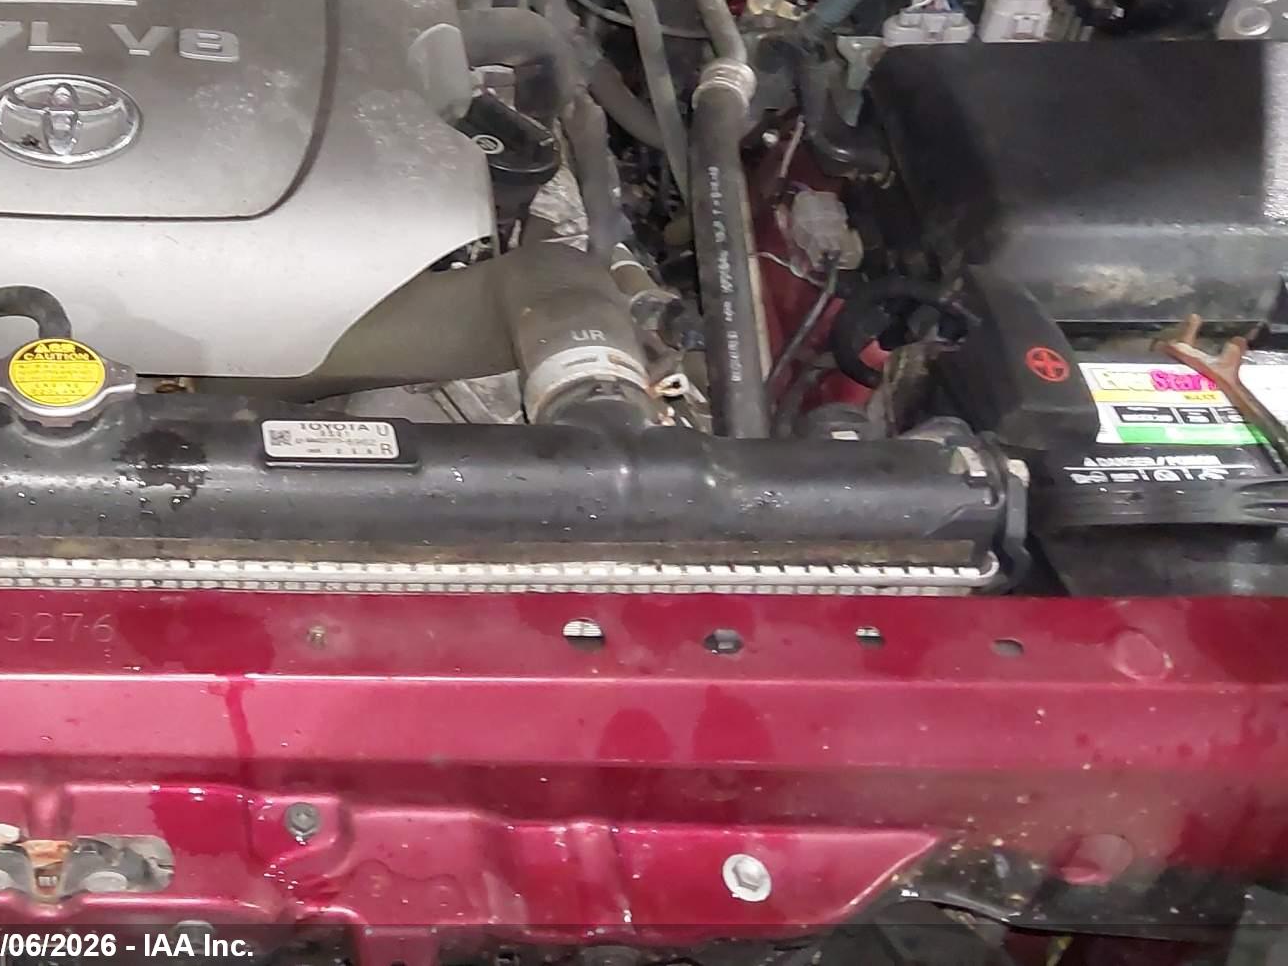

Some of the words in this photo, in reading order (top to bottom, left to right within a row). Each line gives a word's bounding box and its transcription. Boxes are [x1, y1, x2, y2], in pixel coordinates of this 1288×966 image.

[108, 24, 240, 63] V8
[571, 329, 607, 341] UR
[23, 352, 89, 361] CAUTION
[300, 422, 370, 432] TOYOTA
[376, 425, 390, 437] U
[379, 442, 394, 455] R
